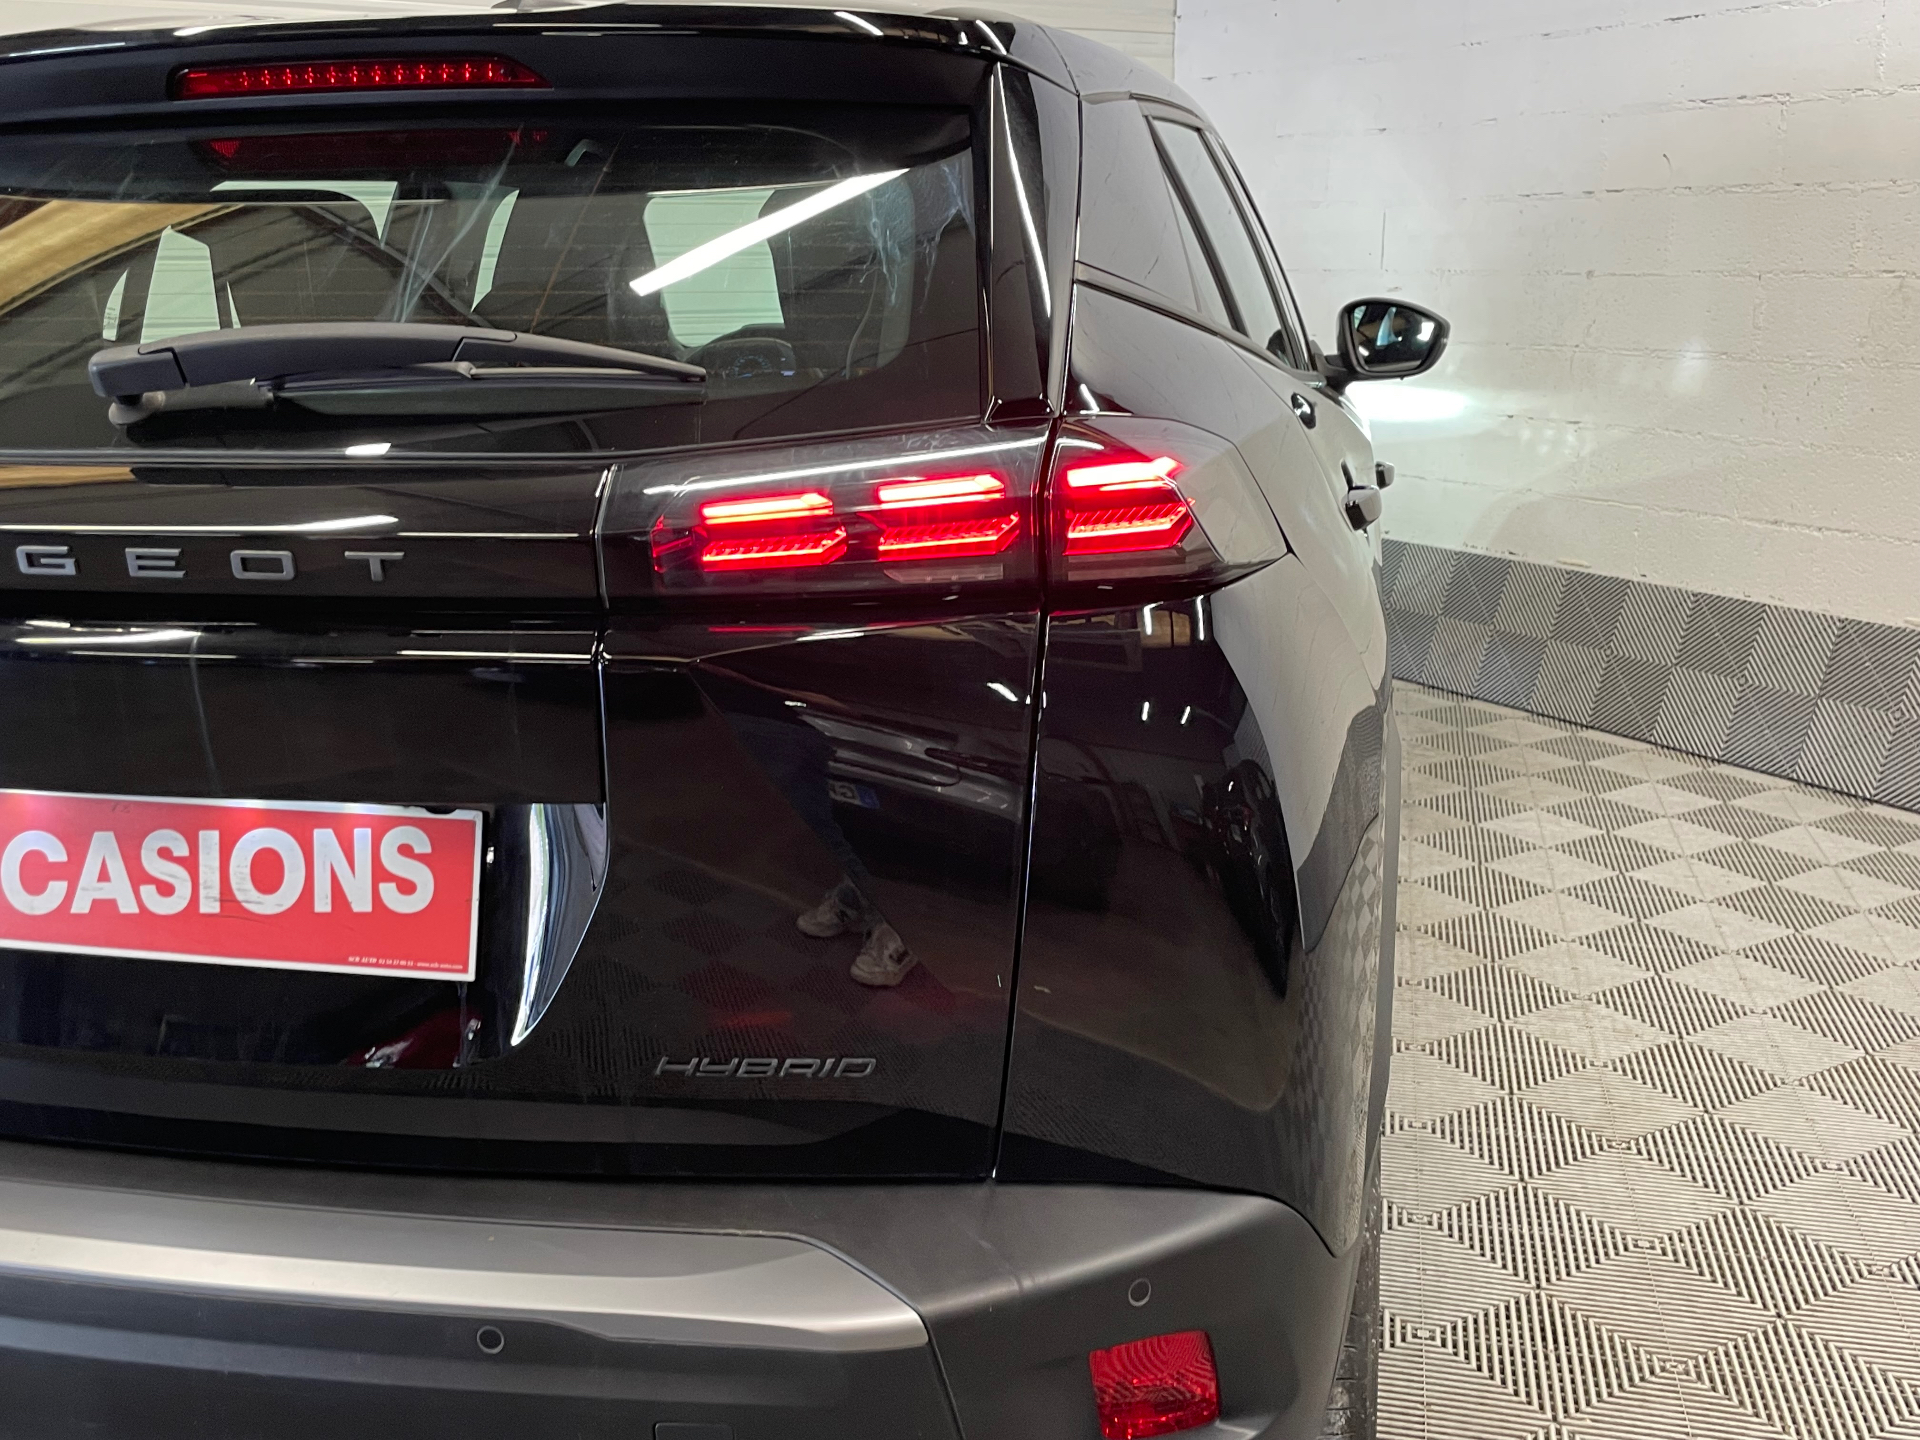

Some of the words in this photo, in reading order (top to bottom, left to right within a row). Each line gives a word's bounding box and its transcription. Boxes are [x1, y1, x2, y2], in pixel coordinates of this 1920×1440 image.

[15, 545, 405, 582] GEOT
[0, 825, 435, 916] CASIONS
[655, 1055, 877, 1078] HYBRID
